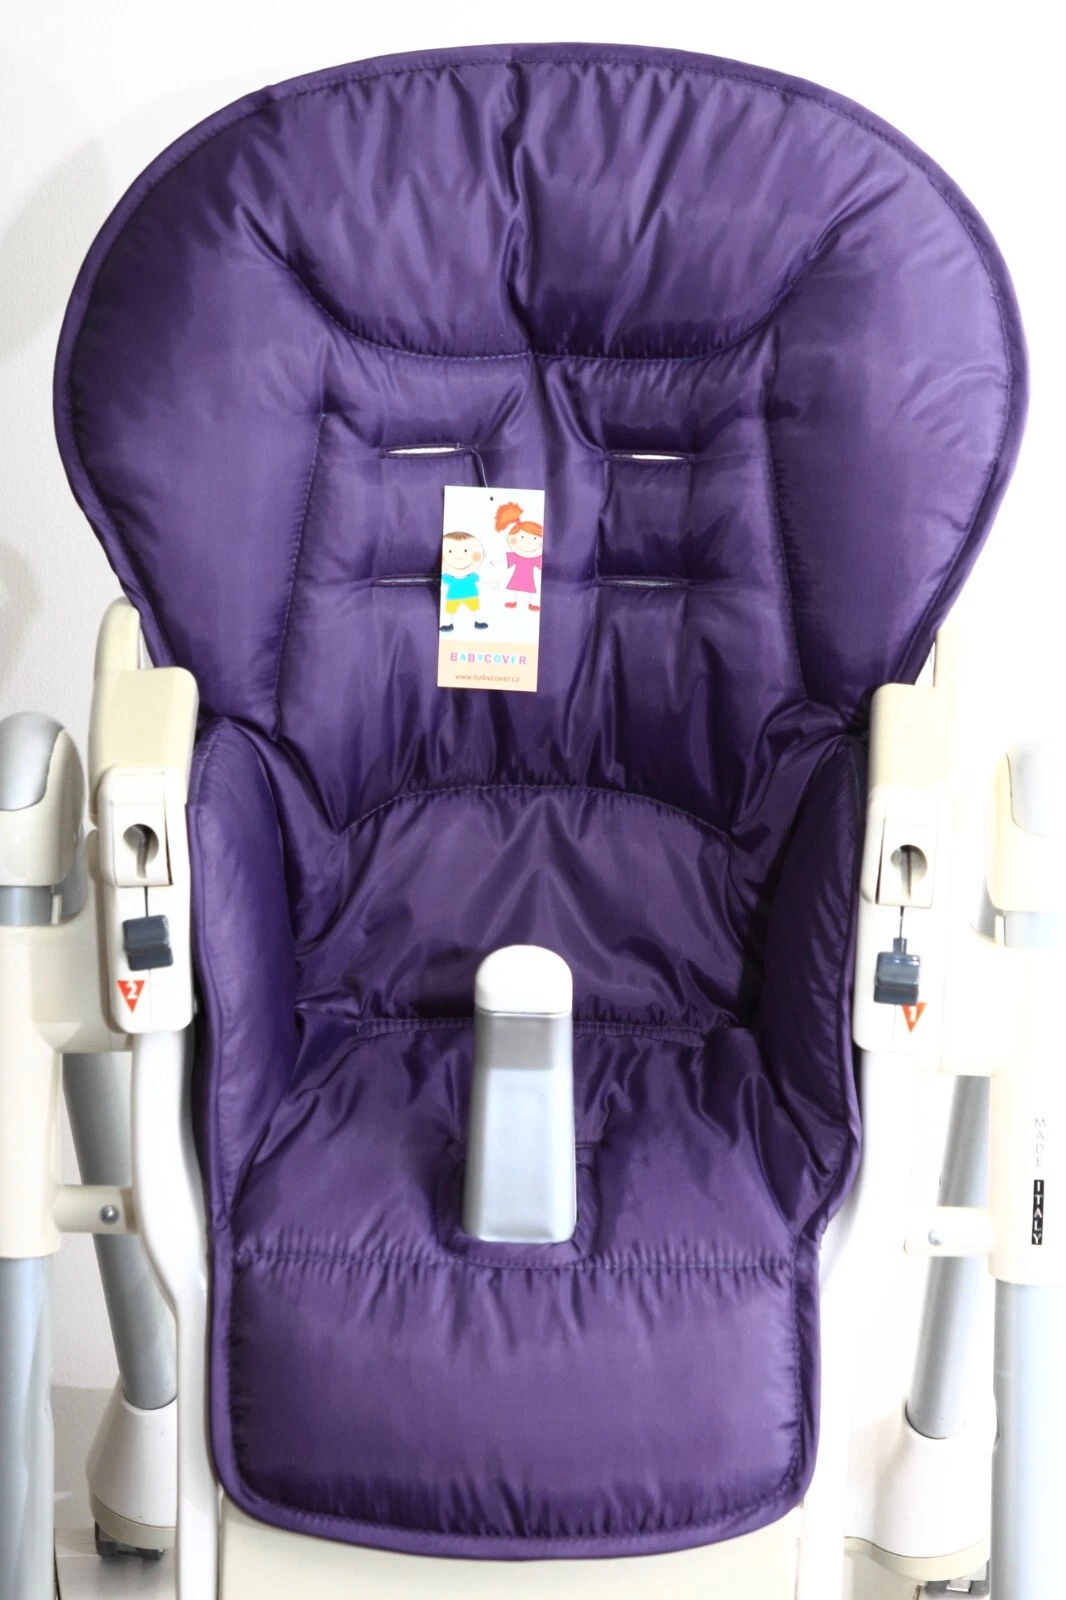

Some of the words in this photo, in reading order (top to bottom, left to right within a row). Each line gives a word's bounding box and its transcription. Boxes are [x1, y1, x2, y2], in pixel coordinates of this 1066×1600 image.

[450, 652, 527, 665] BABYCOVER
[455, 674, 520, 683] www.babycover.cz
[126, 980, 138, 999] 2
[1034, 1117, 1046, 1167] MADE
[1032, 1181, 1043, 1244] ITALY
